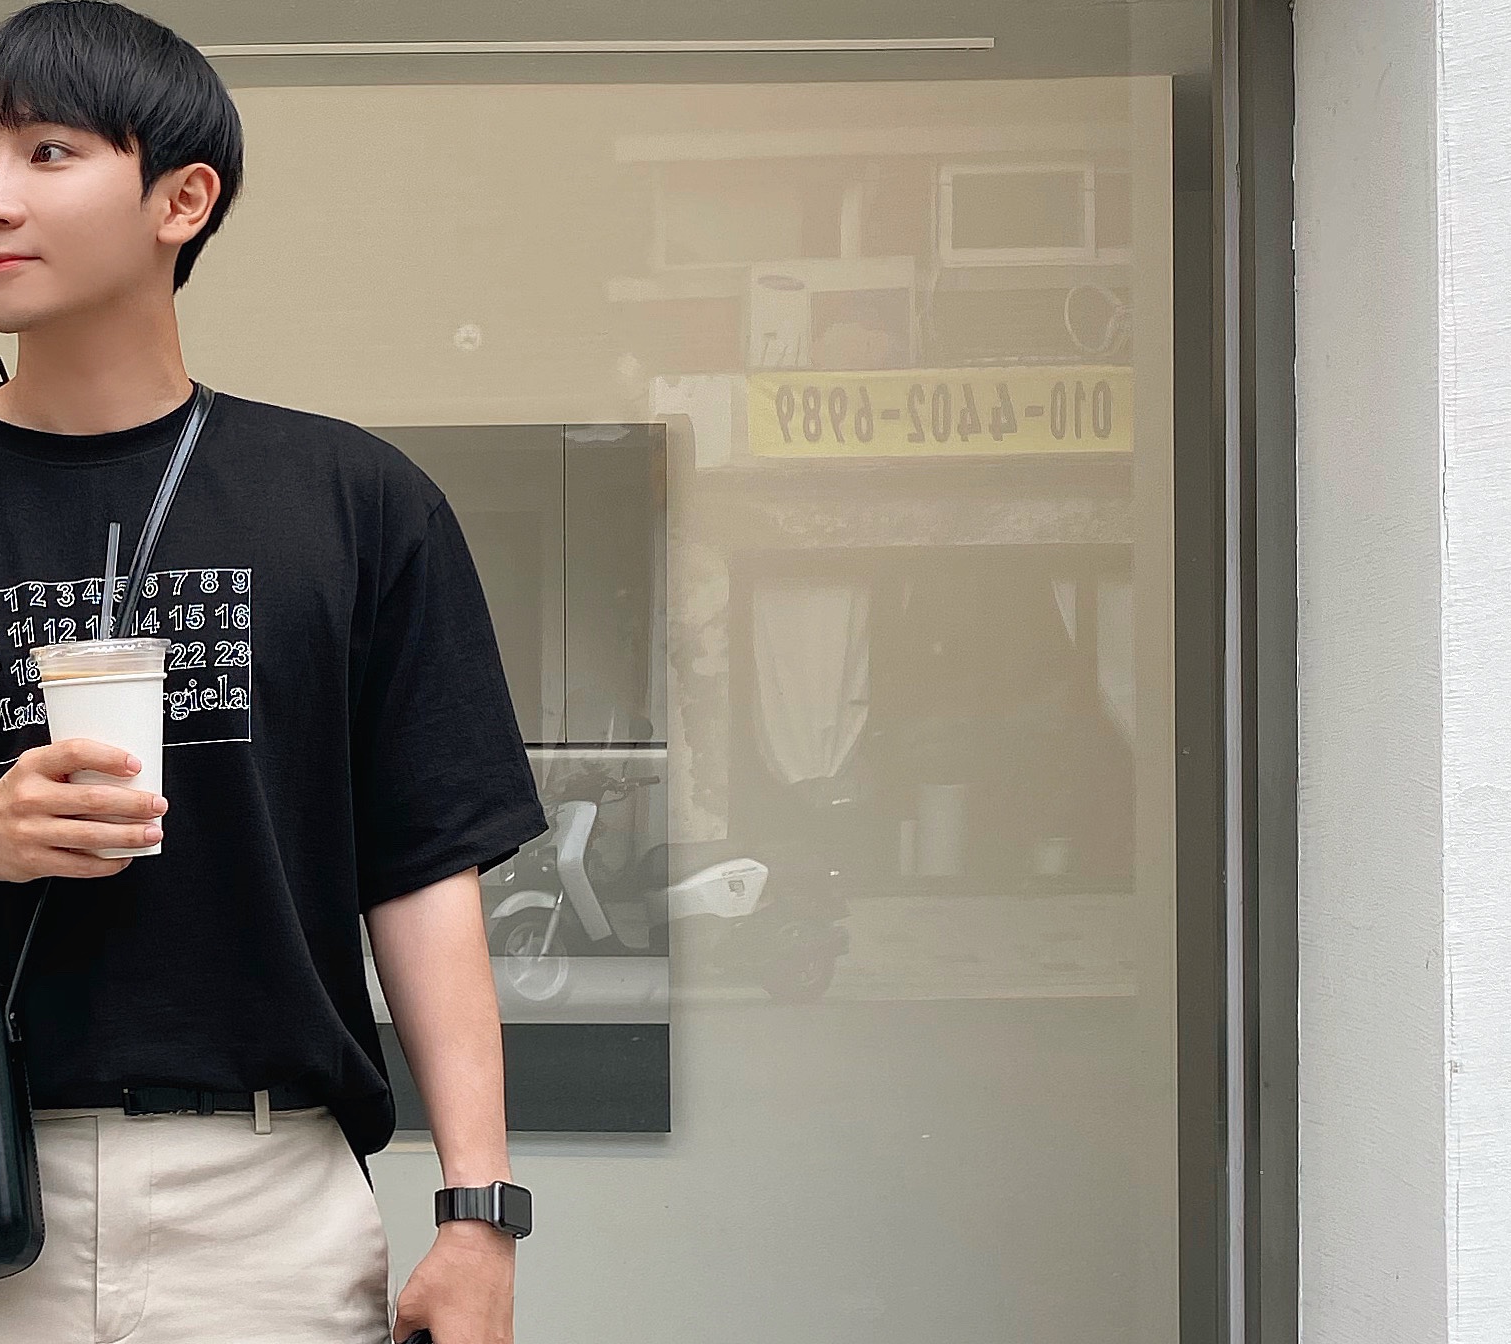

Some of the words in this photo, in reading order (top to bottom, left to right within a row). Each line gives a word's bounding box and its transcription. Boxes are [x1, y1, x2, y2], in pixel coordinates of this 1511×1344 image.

[3, 588, 19, 613] 1
[28, 582, 47, 607] 2
[56, 583, 76, 607] 3
[81, 578, 102, 605] 4
[141, 574, 159, 599] 6
[169, 570, 189, 596] 7
[199, 569, 220, 594] 8
[231, 569, 250, 594] 9
[7, 617, 36, 648] 11
[42, 617, 78, 644] 12
[168, 603, 206, 631] 15
[214, 602, 250, 630] 16
[9, 656, 42, 687] 18
[168, 641, 207, 672] 22
[213, 640, 250, 668] 23
[162, 674, 250, 721] giela
